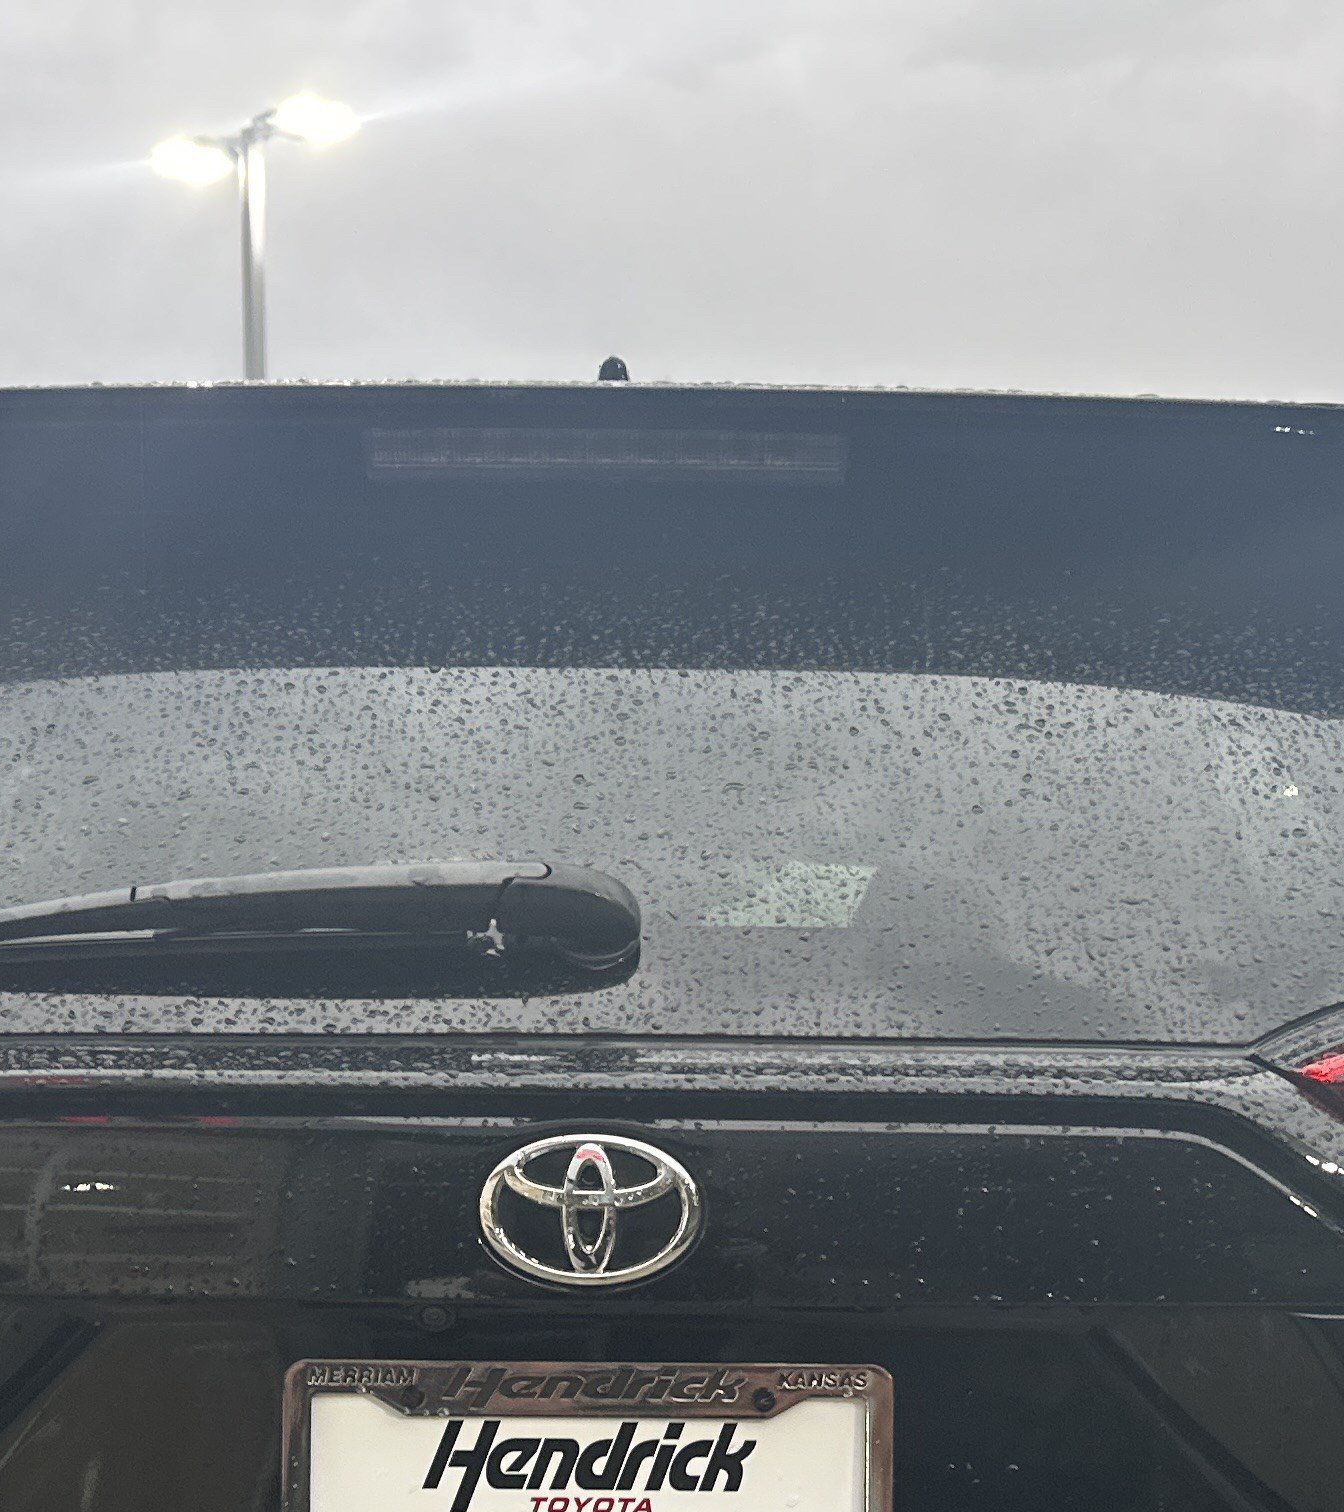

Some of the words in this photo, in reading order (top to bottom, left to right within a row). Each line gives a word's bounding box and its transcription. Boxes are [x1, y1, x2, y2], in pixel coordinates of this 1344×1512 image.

[307, 1366, 419, 1386] MERRIAM
[776, 1371, 869, 1391] KANSAS
[441, 1366, 749, 1412] Hendrick
